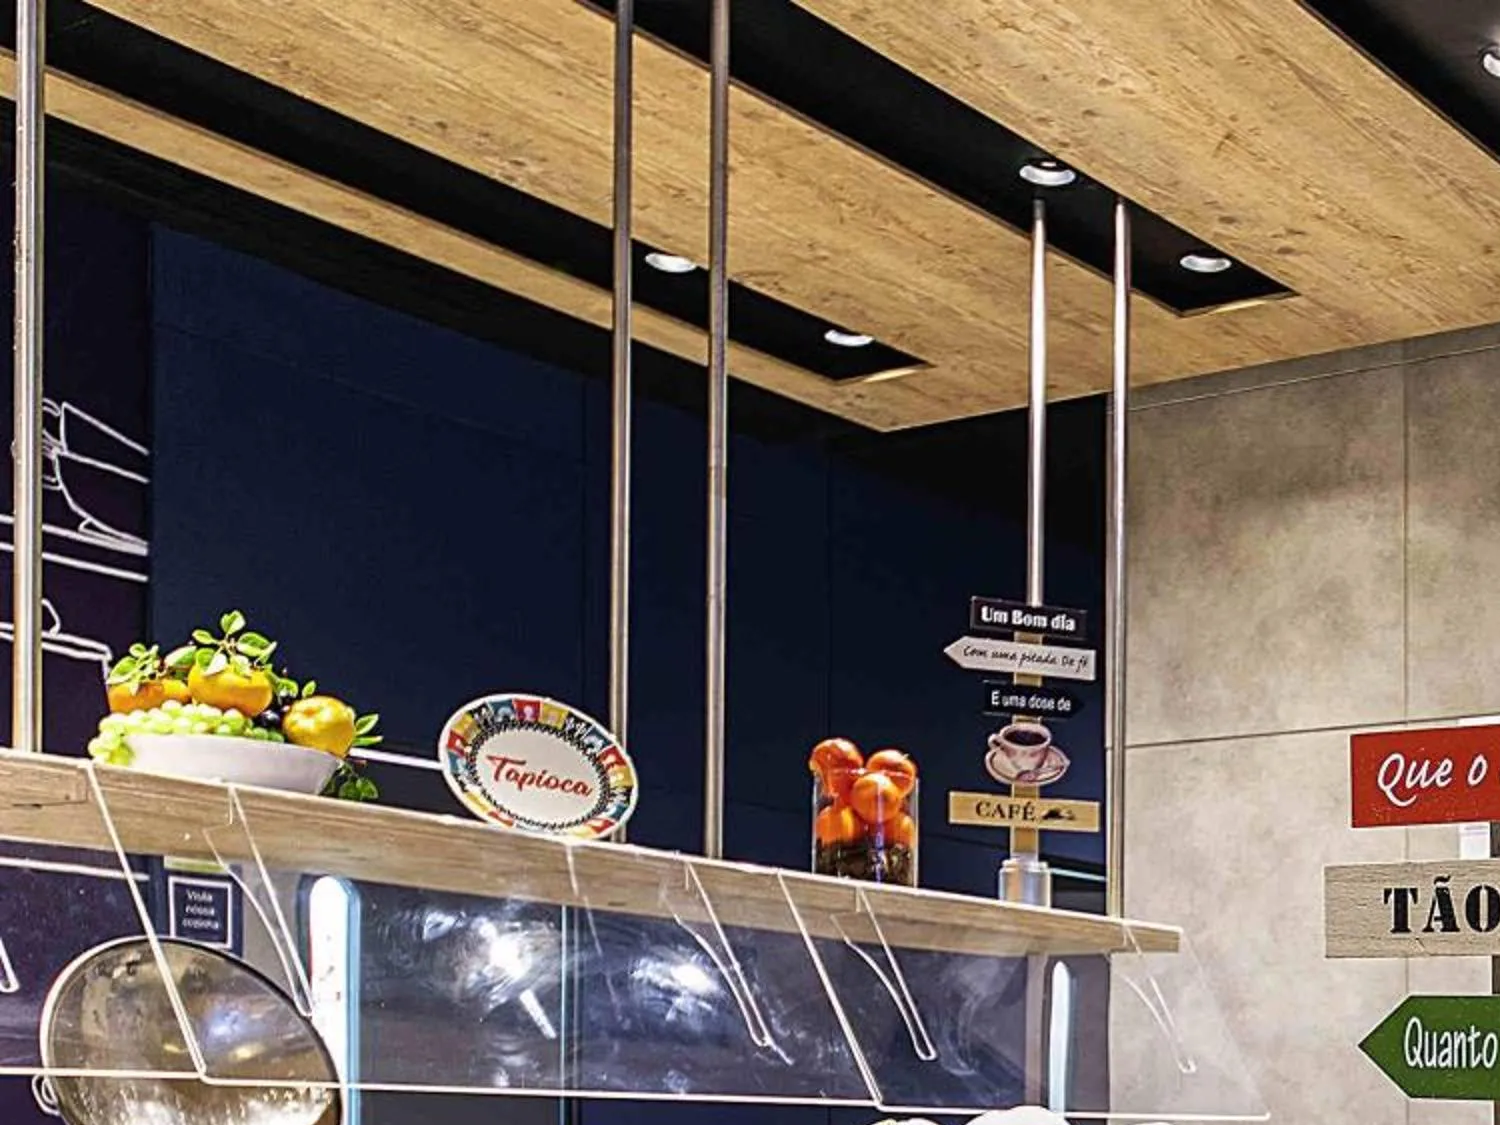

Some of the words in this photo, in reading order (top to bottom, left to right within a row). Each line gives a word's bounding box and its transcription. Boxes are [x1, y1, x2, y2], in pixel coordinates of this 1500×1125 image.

[980, 605, 1008, 625] Um
[1011, 610, 1048, 628] Bom
[1050, 612, 1077, 632] dia
[963, 644, 990, 658] Com
[991, 650, 1017, 662] uma
[990, 690, 1000, 705] E
[1001, 694, 1027, 709] uma
[1028, 693, 1055, 711] dose
[1056, 697, 1072, 712] de
[485, 754, 594, 797] Tapioca
[1376, 752, 1453, 807] Que
[1466, 755, 1489, 786] o
[975, 800, 1037, 821] CAFÉ
[1403, 1015, 1498, 1071] Quanto
